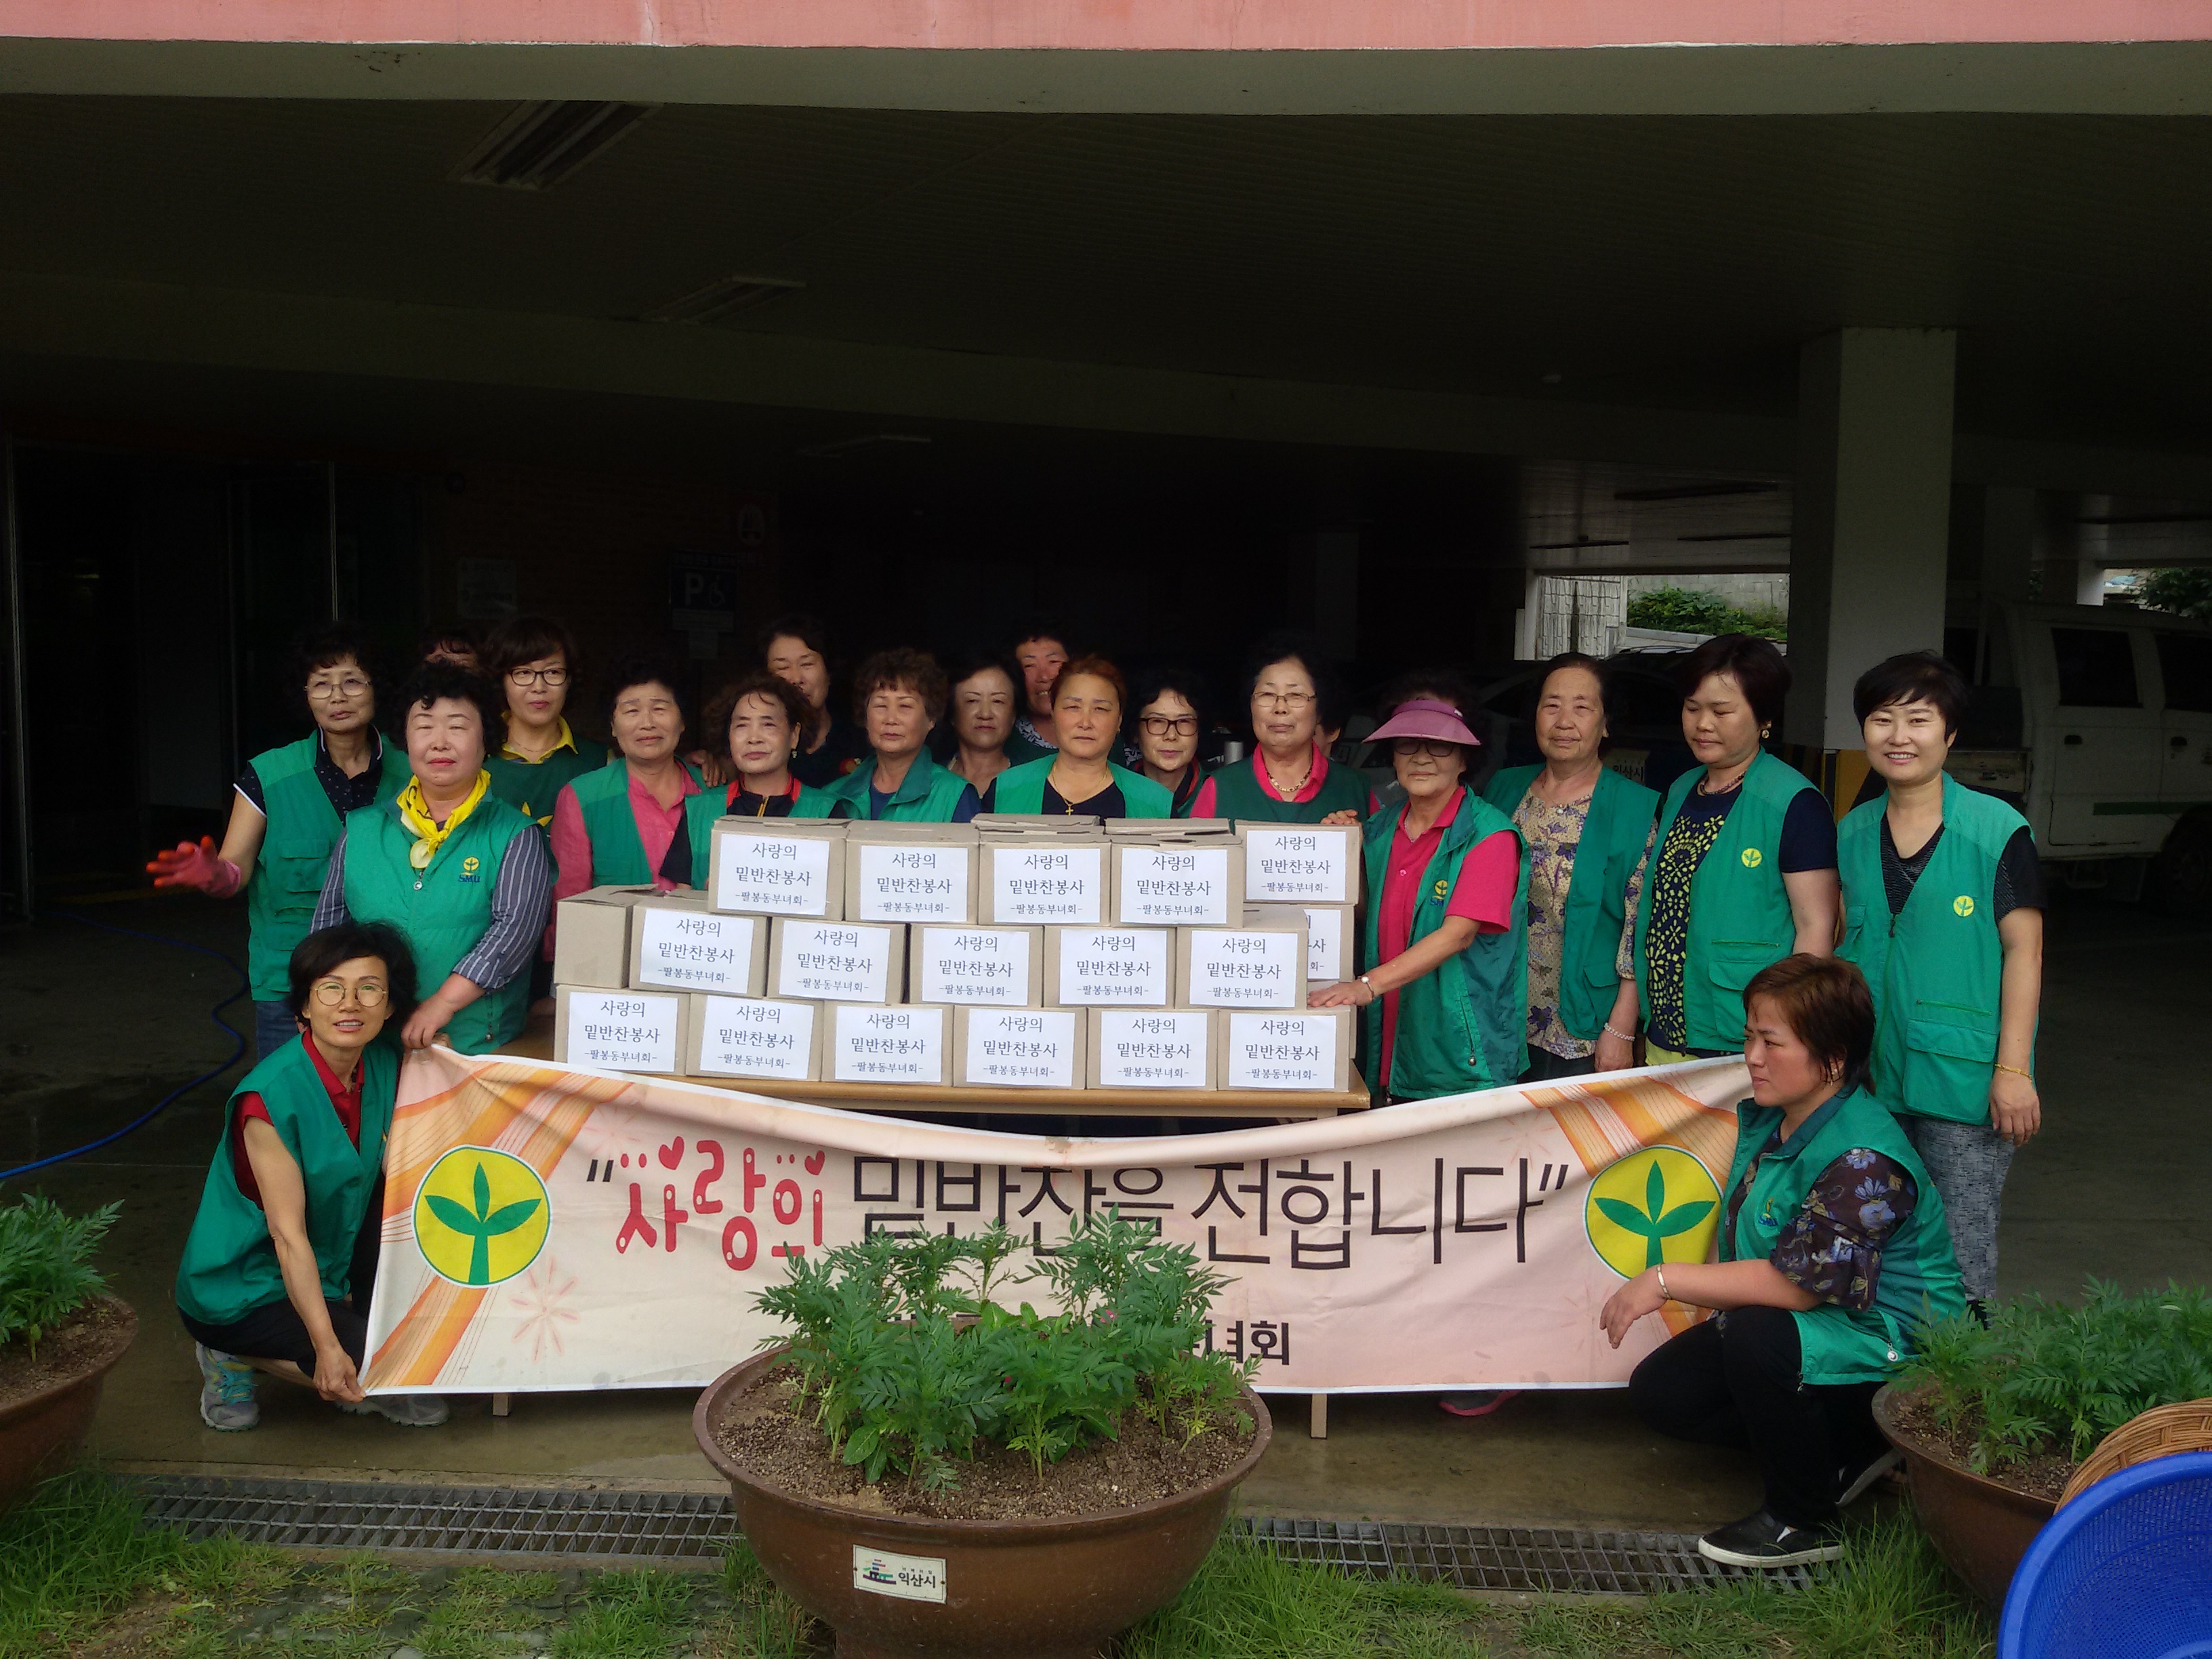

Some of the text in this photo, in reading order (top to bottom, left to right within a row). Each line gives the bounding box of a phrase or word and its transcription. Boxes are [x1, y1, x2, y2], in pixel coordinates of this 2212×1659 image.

[752, 843, 796, 860] 사랑의
[1275, 836, 1315, 851] 사랑의
[893, 853, 935, 868] 사랑의
[1025, 855, 1067, 869] 사랑의
[1152, 855, 1194, 871] 사랑의
[1261, 859, 1330, 874] 밑반찬봉사
[737, 867, 812, 886] 밑반찬봉사
[878, 878, 951, 893] 밑반찬봉사
[1010, 880, 1084, 895] 밑반찬봉사
[1137, 880, 1211, 896] 밑반찬봉사
[677, 919, 720, 937] 사랑의
[814, 930, 857, 947] 사랑의
[955, 936, 997, 951] 사랑의
[1092, 936, 1134, 951] 사랑의
[1223, 938, 1265, 954] 사랑의
[659, 943, 735, 964] 밑반찬봉사
[798, 954, 872, 973] 밑반찬봉사
[940, 960, 1013, 977] 밑반찬봉사
[1077, 960, 1151, 977] 밑반찬봉사
[1208, 962, 1281, 979] 밑반찬봉사
[601, 1000, 644, 1017] 사랑의
[737, 1006, 780, 1023] 사랑의
[867, 1014, 909, 1029] 사랑의
[1000, 1017, 1042, 1032] 사랑의
[1132, 1018, 1174, 1033] 사랑의
[1261, 1020, 1304, 1036] 사랑의
[585, 1025, 660, 1043] 밑반찬봉사
[720, 1029, 794, 1049] 밑반찬봉사
[852, 1038, 925, 1054] 밑반찬봉사
[984, 1040, 1057, 1057] 밑반찬봉사
[1118, 1043, 1191, 1059] 밑반찬봉사
[1246, 1044, 1320, 1061] 밑반찬봉사
[899, 1572, 936, 1589] 익산시
